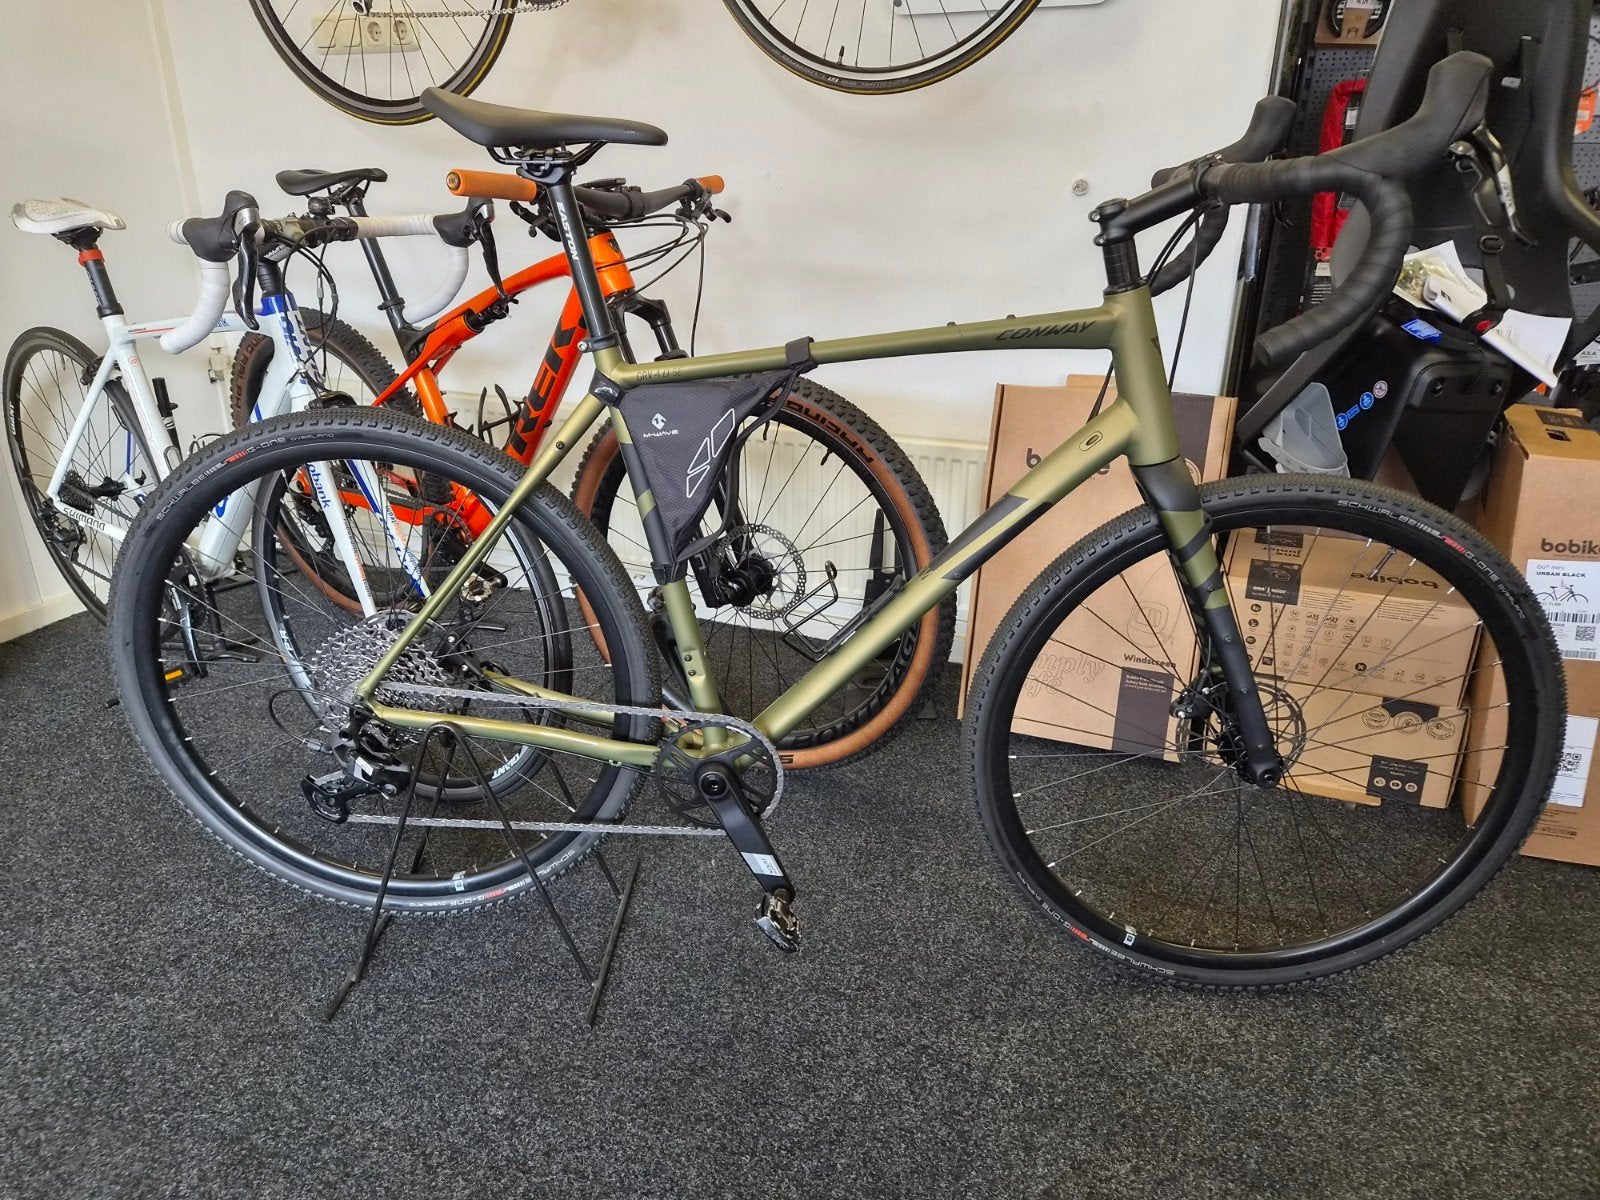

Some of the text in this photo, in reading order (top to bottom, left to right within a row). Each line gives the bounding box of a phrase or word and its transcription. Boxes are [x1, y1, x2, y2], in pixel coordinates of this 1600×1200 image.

[556, 201, 580, 261] EASTON
[996, 320, 1098, 341] CONWAY
[637, 371, 653, 381] GRV
[642, 429, 679, 439] M-WAVE
[785, 400, 875, 464] RACING
[156, 472, 205, 521] SCHWALBE
[248, 437, 287, 453] G-ONE
[62, 506, 106, 532] SHIMANO
[1336, 499, 1420, 527] SCHWALBE
[1464, 551, 1500, 583] G-ONE
[1350, 571, 1440, 590] bobike
[1123, 653, 1177, 668] Windscreen
[491, 753, 521, 780] GIANT
[525, 848, 577, 884] SCHWALE
[1041, 902, 1071, 929] G-ONE
[1110, 949, 1176, 977] SCHWALBE
